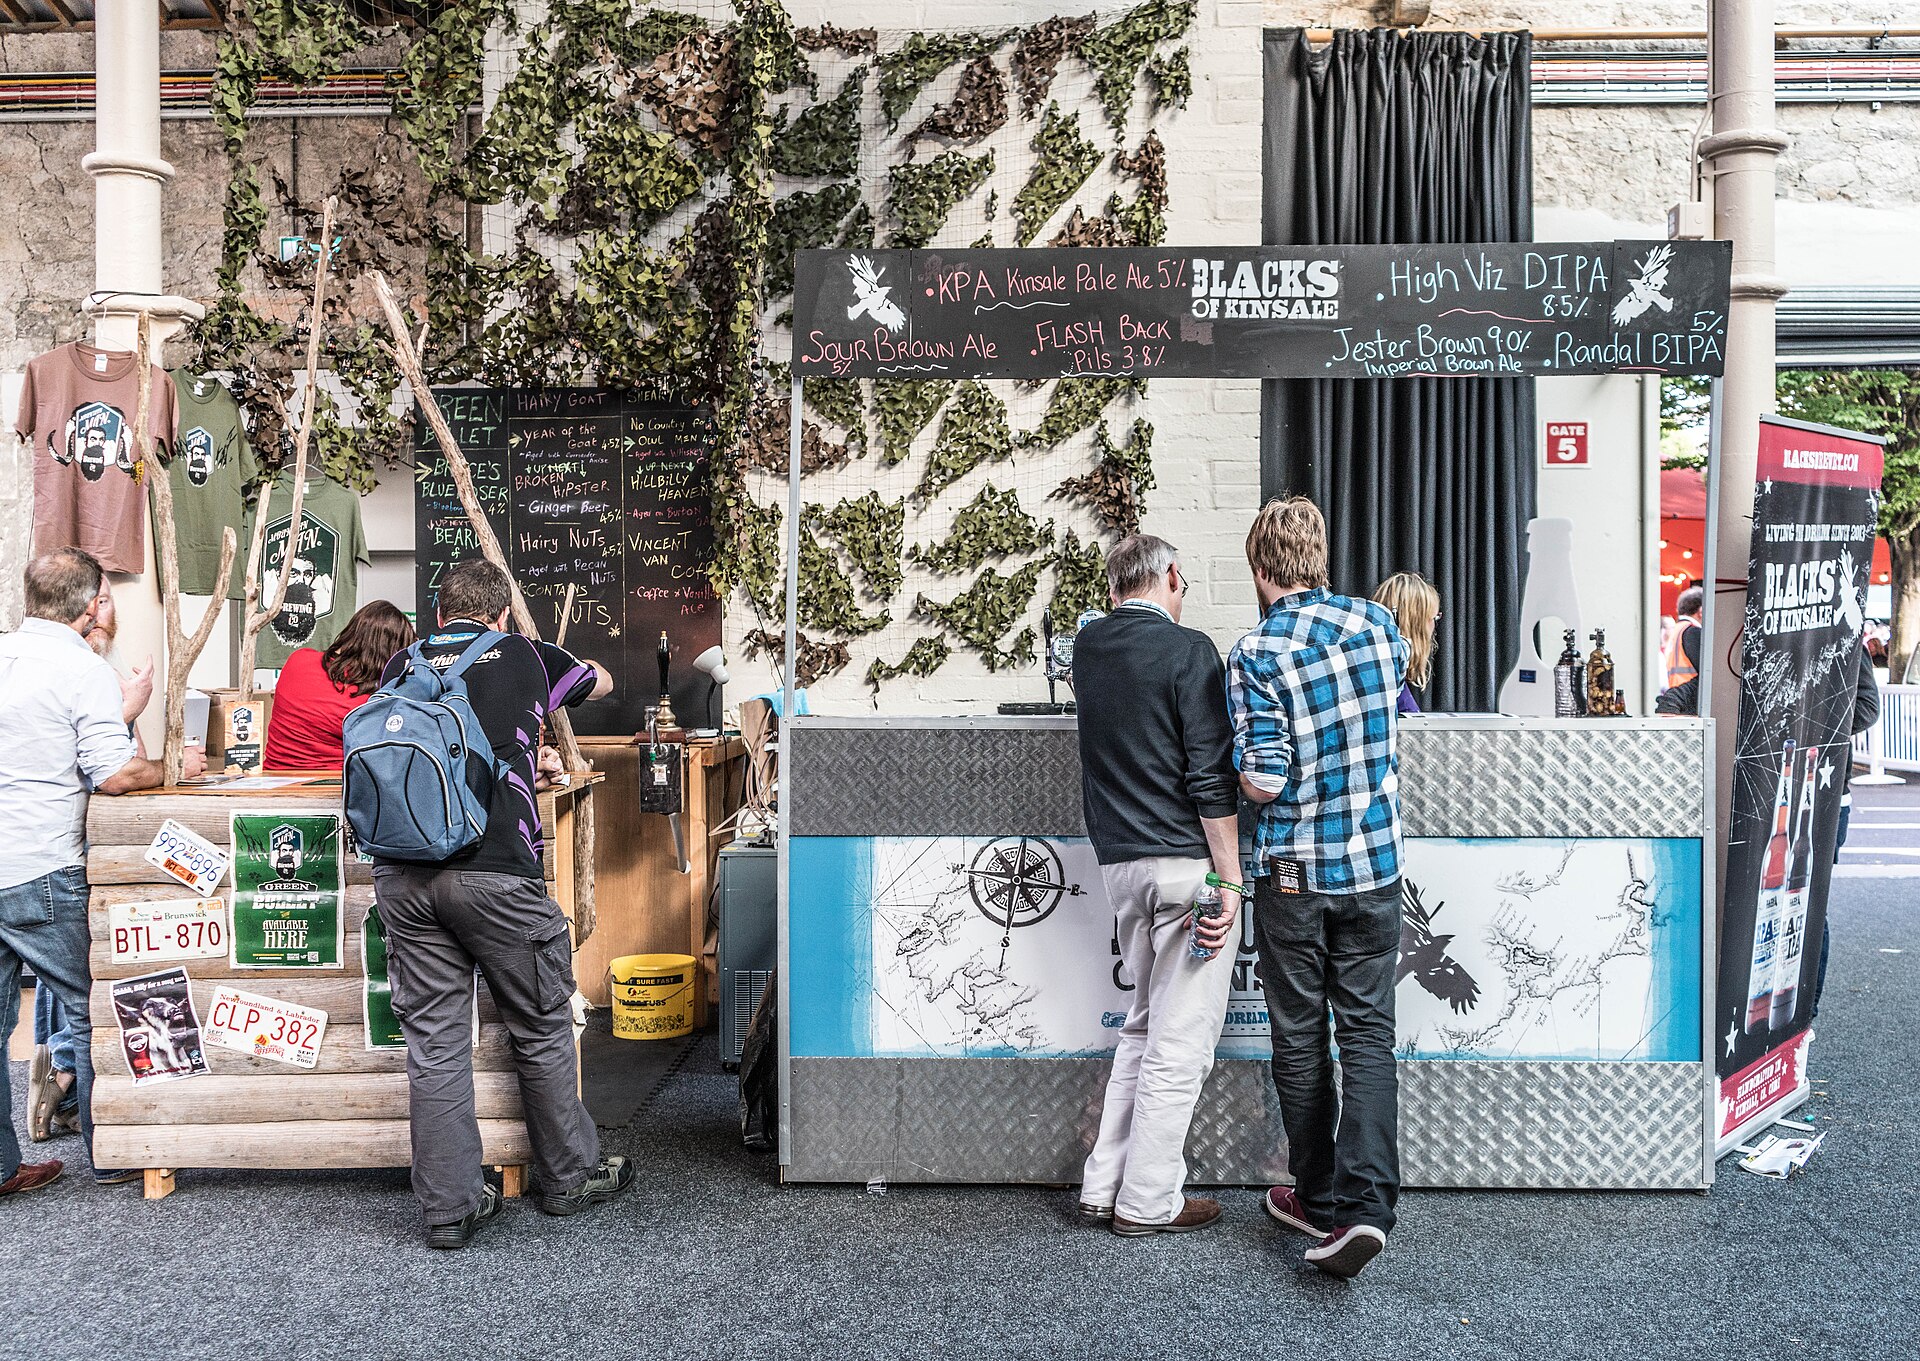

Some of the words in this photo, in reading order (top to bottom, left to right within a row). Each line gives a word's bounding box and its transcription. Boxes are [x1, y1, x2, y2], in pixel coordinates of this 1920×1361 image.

[939, 269, 996, 304] KPA
[1006, 265, 1067, 298] Kinsale
[1076, 263, 1116, 292] Pale
[1125, 262, 1154, 290] Ale
[1157, 258, 1188, 290] 5%
[1192, 258, 1339, 298] BLACKS
[1390, 260, 1460, 303] High
[1467, 253, 1508, 293] Viz
[1525, 252, 1610, 293] DIPA
[1192, 299, 1220, 319] OF
[1225, 299, 1339, 319] KINSALE
[1035, 319, 1104, 351] FLASH
[1332, 327, 1412, 361] Jester
[1417, 323, 1489, 357] Brown
[962, 334, 999, 359] Ale
[1555, 331, 1643, 369] Randal
[1651, 332, 1722, 365] BIPA
[831, 359, 852, 376] 5%
[1074, 346, 1113, 372] Pils
[1446, 356, 1494, 374] Brown
[1499, 355, 1524, 373] Ale
[423, 394, 504, 425] REEN
[561, 426, 574, 437] of
[579, 423, 597, 435] the
[630, 417, 645, 431] No
[1549, 425, 1586, 436] GATE
[422, 426, 497, 446] BLET
[1557, 437, 1578, 461] 5
[434, 458, 502, 480] BCE'S
[519, 531, 559, 554] Hairy
[628, 530, 693, 552] VINCENT
[1765, 523, 1795, 542] LIVING
[641, 554, 669, 567] VAN
[526, 583, 588, 598] CONTANS
[1763, 559, 1837, 611] BLACKS
[281, 602, 313, 615] REWING
[1763, 610, 1780, 635] OF
[1779, 604, 1833, 633] KINSALE
[404, 648, 502, 673] thinn's
[156, 832, 186, 860] 992
[190, 853, 221, 881] 896
[264, 882, 310, 891] GREEN
[252, 894, 320, 910] BULLET
[164, 909, 208, 920] Brunswick
[262, 919, 309, 930] AVAILABLE
[115, 921, 221, 954] BTL-870
[263, 930, 309, 949] HERE
[1000, 936, 1010, 948] S
[219, 993, 274, 1013] Newfoundland
[285, 1010, 321, 1024] Labrador
[213, 1002, 260, 1034] CLP
[270, 1016, 318, 1050] 382
[297, 1049, 315, 1057] SEPT
